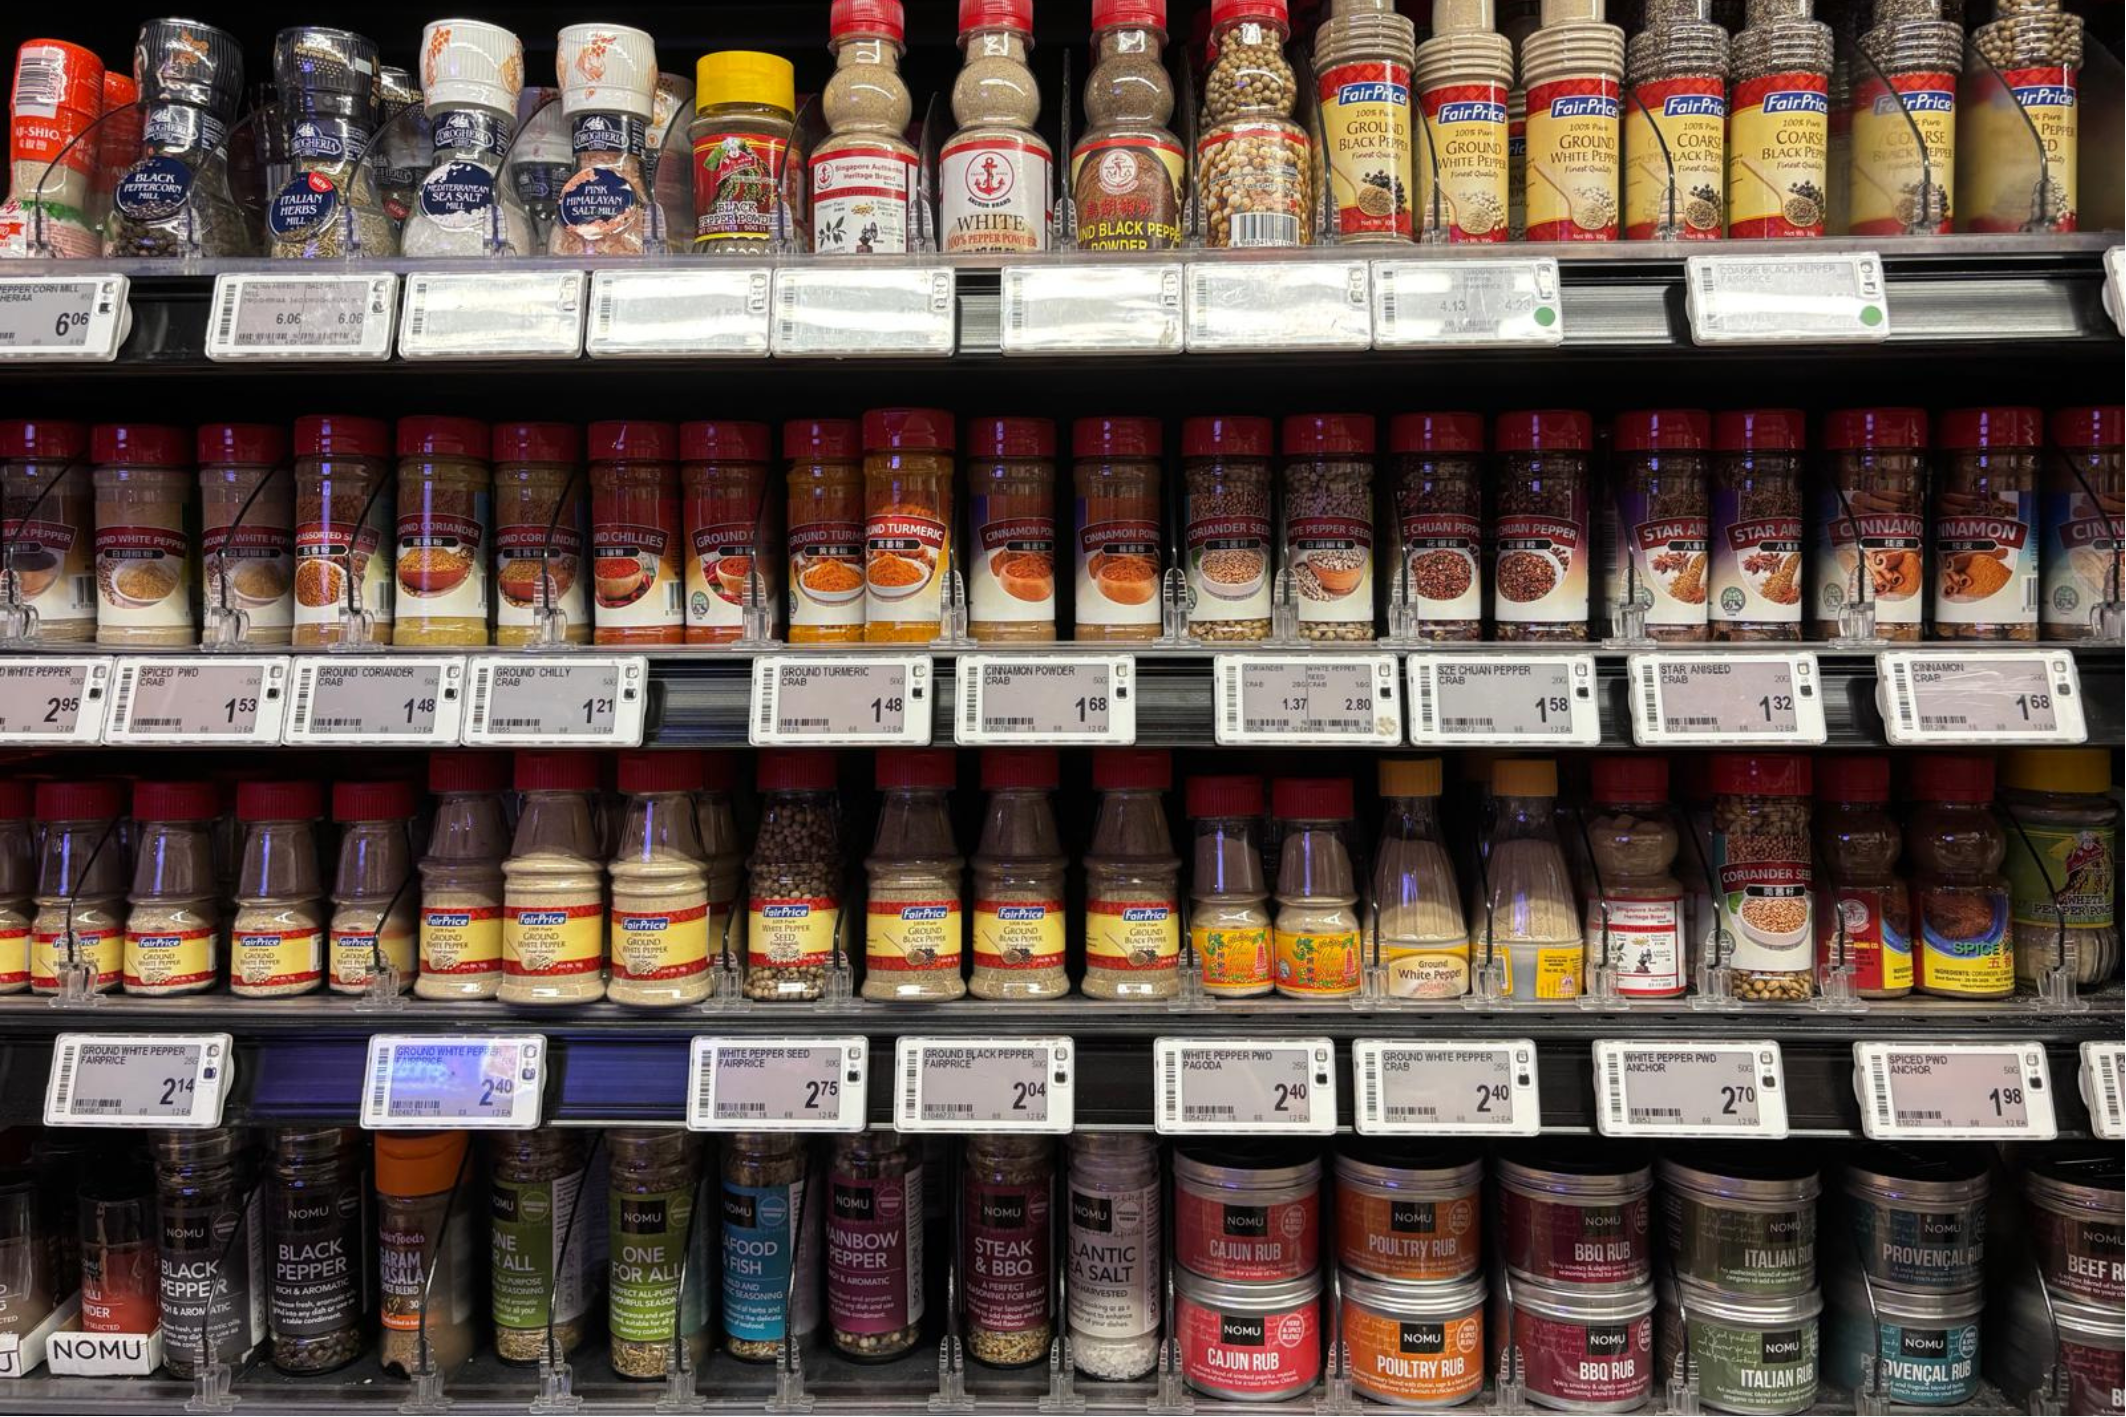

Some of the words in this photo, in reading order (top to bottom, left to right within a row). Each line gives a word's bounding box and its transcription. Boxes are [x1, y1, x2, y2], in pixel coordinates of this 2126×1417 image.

[1342, 85, 1406, 104] FairPrice
[1554, 98, 1617, 116] FairPrice
[1442, 105, 1505, 122] FairPrice
[1346, 122, 1404, 136] GROUND
[1339, 137, 1375, 151] BLACK
[1560, 134, 1614, 149] GROUND
[1446, 142, 1502, 154] GROUND
[1551, 151, 1588, 163] WHITE
[1763, 148, 1801, 160] BLACK
[135, 173, 175, 183] BLACK
[124, 184, 183, 194] PEPPERCORN
[427, 184, 489, 194] MEDITERRANEAN
[584, 185, 607, 195] PINK
[280, 194, 322, 205] ITALIAN
[432, 192, 454, 202] SEA
[456, 193, 481, 203] SALT
[567, 196, 622, 205] HIMALAYAN
[280, 205, 317, 216] HERBS
[445, 202, 465, 210] MILL
[572, 206, 596, 216] SALT
[597, 207, 617, 215] MILL
[957, 213, 1024, 232] WHITE
[1099, 223, 1144, 236] BLACK
[30, 528, 72, 542] PEPPER
[421, 522, 479, 539] CORIANDER
[889, 524, 943, 541] TURMERIC
[986, 527, 1038, 542] CINNAMON
[1305, 524, 1346, 536] PEPPER
[1533, 524, 1577, 539] PEPPER
[1643, 523, 1687, 542] STAR
[116, 534, 150, 545] WHITE
[611, 532, 664, 548] CHILLIES
[697, 531, 748, 548] GROUND
[8, 667, 35, 676] WHITE
[36, 667, 72, 676] PEPPER
[140, 667, 173, 677] SPICED
[178, 667, 198, 677] PWD
[320, 667, 357, 677] GROUND
[362, 667, 414, 677] CORIANDER
[496, 667, 535, 677] GROUND
[538, 666, 571, 677] CHILLY
[782, 667, 821, 677] GROUND
[824, 667, 869, 676] TURMERIC
[985, 666, 1032, 675] CINNAMON
[1036, 665, 1075, 675] POWDER
[1438, 666, 1455, 675] SZE
[1458, 666, 1491, 675] CHUAN
[1494, 666, 1530, 675] PEPPER
[1659, 664, 1687, 676] STAR
[1691, 664, 1731, 674] ANISEED
[1912, 663, 1964, 671] CINNAMON
[139, 678, 165, 686] CRAB
[318, 678, 343, 686] CRAB
[495, 678, 520, 686] CRAB
[781, 678, 806, 686] CRAB
[985, 677, 1010, 685] CRAB
[1439, 676, 1465, 684] CRAB
[1661, 675, 1688, 684] CRAB
[1283, 698, 1308, 710] 1.37
[1346, 699, 1371, 710] 2.80
[1723, 868, 1793, 883] CORIANDER
[764, 907, 808, 917] FairPrice
[903, 909, 947, 919] FairPrice
[428, 916, 469, 926] FairPrice
[519, 914, 565, 925] FairPrice
[140, 938, 179, 947] FairPrice
[1418, 959, 1448, 968] Ground
[1398, 968, 1430, 979] White
[1432, 968, 1462, 981] Pepper
[82, 1046, 120, 1055] GROUND
[122, 1047, 149, 1055] WHITE
[150, 1047, 185, 1055] PEPPER
[749, 1049, 783, 1058] PEPPER
[783, 1049, 810, 1058] SEED
[925, 1049, 963, 1058] GROUND
[966, 1049, 996, 1060] BLACK
[998, 1050, 1034, 1058] PEPPER
[1182, 1051, 1211, 1059] WHITE
[1214, 1051, 1249, 1060] PEPPER
[1252, 1051, 1273, 1060] PWD
[81, 1056, 126, 1064] FAIRPRICE
[718, 1059, 765, 1067] FAIRPRICE
[1383, 1052, 1423, 1063] GROUND
[1425, 1052, 1453, 1061] WHITE
[1456, 1052, 1493, 1061] PEPPER
[1624, 1053, 1655, 1062] WHITE
[1656, 1053, 1693, 1062] PEPPER
[1696, 1053, 1716, 1062] PWD
[1888, 1055, 1923, 1064] SPICED
[1925, 1055, 1947, 1064] PWD
[924, 1059, 971, 1068] FAIRPRICE
[1183, 1061, 1222, 1070] PAGODA
[1383, 1062, 1410, 1071] CRAB
[1626, 1063, 1666, 1072] ANCHOR
[1891, 1066, 1931, 1074] ANCHOR
[835, 1195, 870, 1211] NOMU
[288, 1206, 329, 1219] NOMU
[983, 1205, 1021, 1219] NOMU
[623, 1212, 662, 1224] NOMU
[167, 1229, 204, 1238] NOMU
[279, 1238, 343, 1260] BLACK
[975, 1238, 1034, 1256] STEAK
[1210, 1240, 1251, 1262] CAJUN
[1255, 1242, 1282, 1261] RUB
[1368, 1234, 1426, 1257] POULTRY
[1432, 1238, 1456, 1258] RUB
[622, 1247, 665, 1263] ONE
[829, 1249, 887, 1269] PEPPER
[1883, 1243, 1966, 1270] PROVENÇAL
[162, 1260, 219, 1277] BLACK
[503, 1256, 536, 1271] ALL
[730, 1258, 762, 1275] FISH
[975, 1258, 988, 1274] &
[992, 1258, 1034, 1276] BBQ
[2068, 1254, 2106, 1278] BEEF
[276, 1258, 347, 1281] PEPPER
[612, 1265, 643, 1283] FOR
[649, 1264, 681, 1281] ALL
[1091, 1265, 1135, 1283] SALT
[1224, 1325, 1261, 1336] NOMU
[1403, 1332, 1441, 1343] NOMU
[1590, 1334, 1625, 1345] NOMU
[53, 1340, 141, 1360] NOMU
[1765, 1342, 1799, 1354] NOMU
[1208, 1349, 1251, 1371] CAJUN
[1253, 1352, 1279, 1370] RUB
[1377, 1356, 1442, 1379] POULTRY
[1444, 1357, 1465, 1374] RUB
[1580, 1363, 1609, 1381] BBQ
[1612, 1359, 1635, 1380] RUB
[1741, 1370, 1794, 1388] ITALIAN
